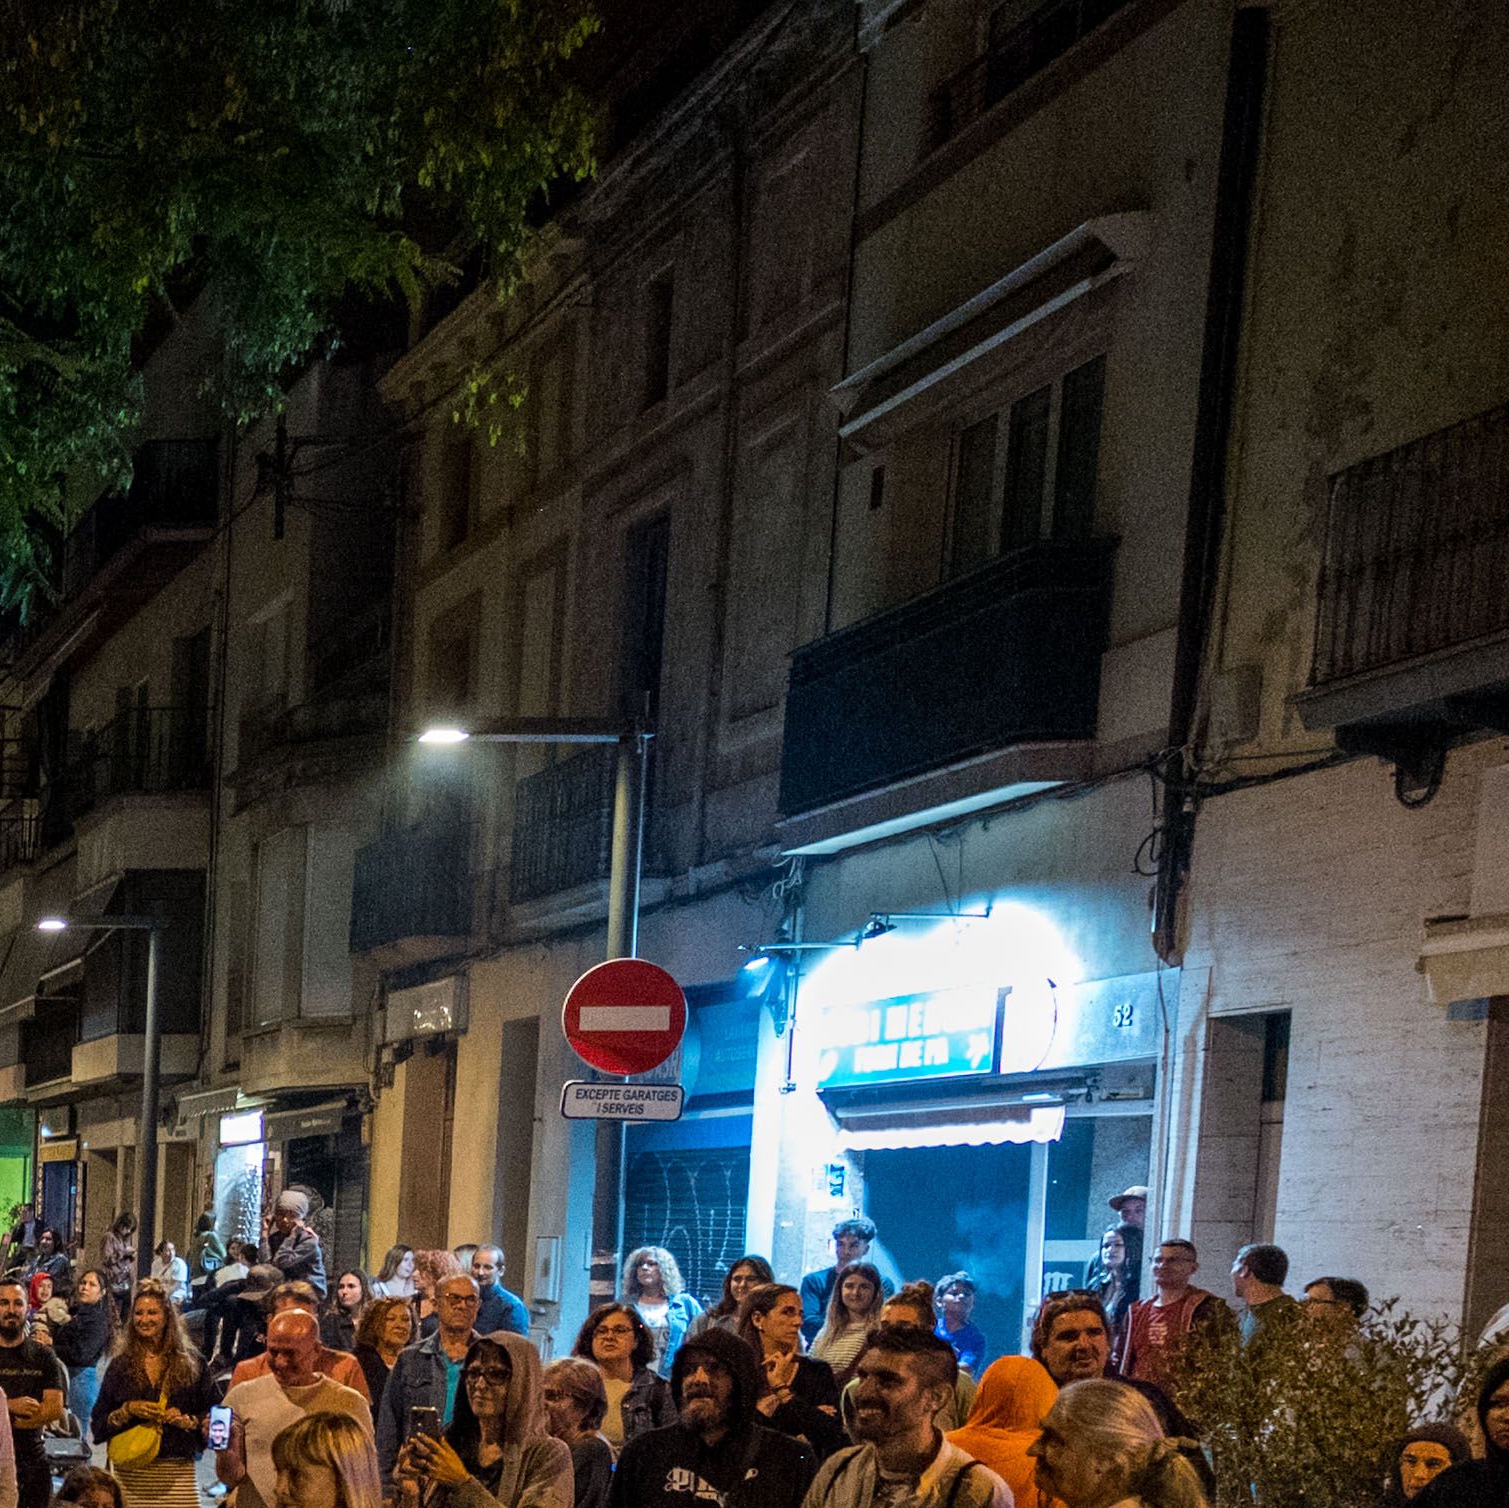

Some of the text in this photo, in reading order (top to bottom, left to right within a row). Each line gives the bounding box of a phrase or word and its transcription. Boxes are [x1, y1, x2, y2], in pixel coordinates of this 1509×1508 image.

[1112, 1003, 1134, 1027] 52
[575, 1088, 678, 1101] EXCEPTE GARATGES
[602, 1103, 645, 1115] SERVEIS
